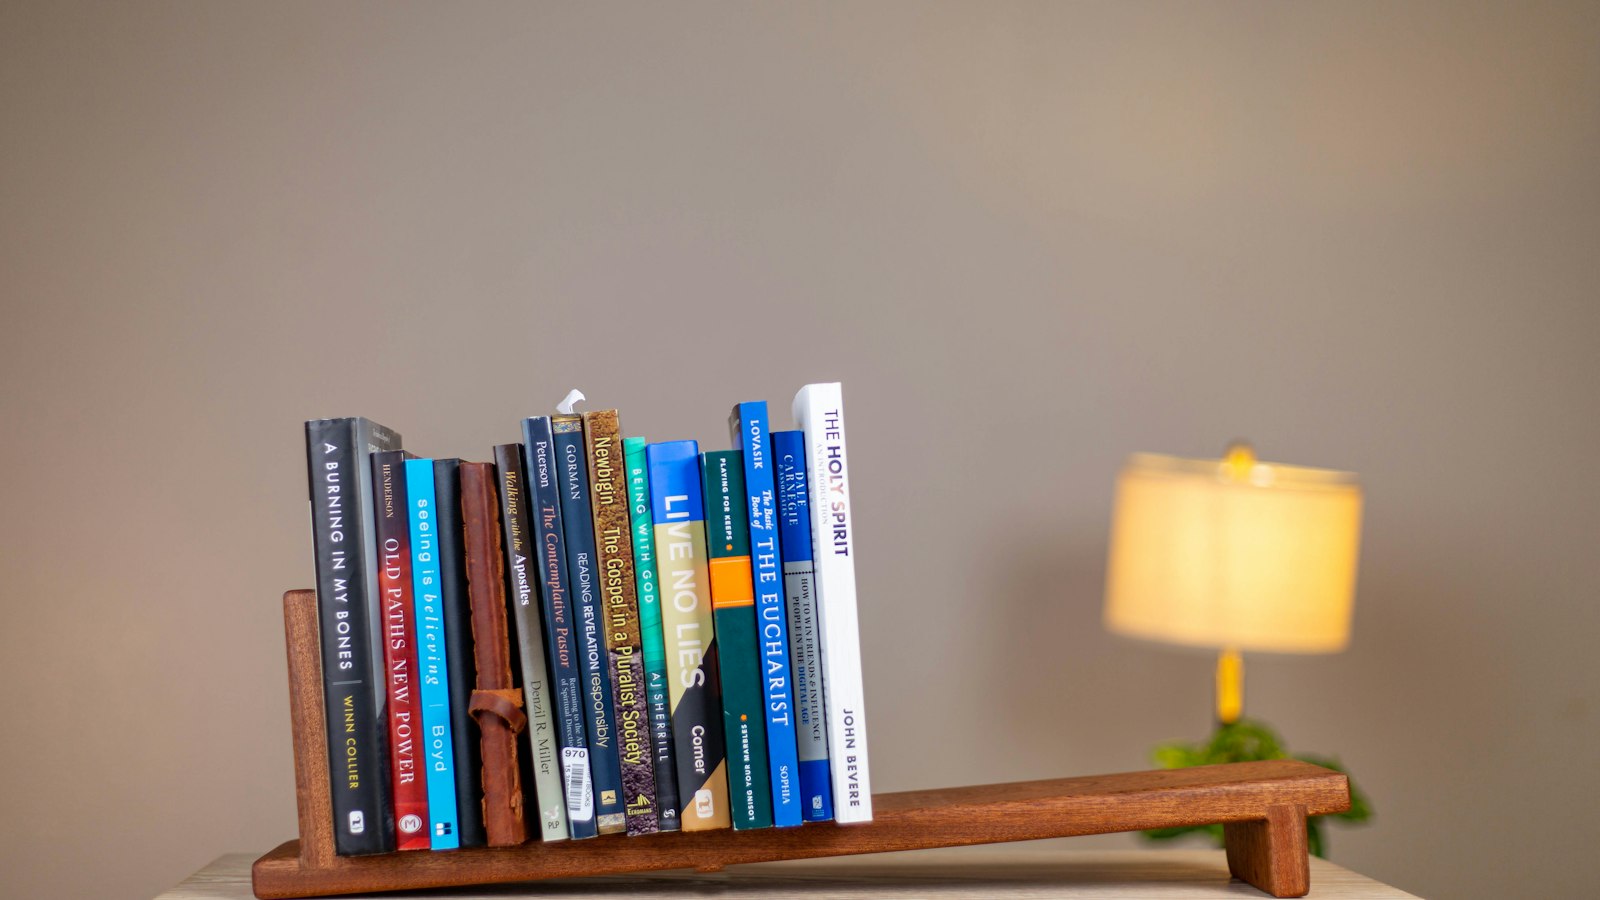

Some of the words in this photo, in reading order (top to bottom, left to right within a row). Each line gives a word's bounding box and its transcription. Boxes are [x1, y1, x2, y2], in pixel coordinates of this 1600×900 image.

[750, 419, 763, 470] LOVASIK
[824, 408, 841, 441] THE
[324, 442, 338, 454] A
[536, 441, 550, 488] Peterson
[816, 443, 823, 455] AN
[382, 464, 394, 518] HENDERSON
[566, 444, 581, 500] GORMAN
[594, 437, 616, 505] Newbigin
[632, 468, 646, 514] BEING
[719, 457, 729, 494] PLAYING
[783, 454, 799, 526] CARNEGIE
[795, 471, 807, 507] DALE
[827, 446, 844, 495] HOLY
[325, 462, 344, 543] BURNING
[504, 471, 518, 515] Walking
[722, 495, 731, 512] FOR
[751, 495, 763, 518] Book
[762, 489, 772, 506] The
[817, 457, 828, 526] INTRODUCTION
[417, 499, 433, 562] seeing
[510, 516, 520, 538] with
[543, 505, 555, 529] The
[664, 494, 694, 561] LIVE
[724, 514, 733, 541] KEEPS
[751, 519, 764, 530] of
[763, 508, 774, 531] Basic
[830, 500, 849, 557] SPIRIT
[331, 551, 346, 569] IN
[384, 538, 401, 580] OLD
[512, 538, 522, 551] the
[603, 527, 620, 554] The
[638, 523, 651, 561] WITH
[757, 537, 777, 583] THE
[333, 579, 348, 603] MY
[422, 570, 433, 585] is
[515, 554, 531, 606] Apostles
[545, 533, 565, 623] Contemplative
[577, 553, 593, 603] READING
[606, 559, 628, 608] Gospel
[642, 570, 655, 603] GOD
[671, 569, 698, 613] NO
[801, 578, 810, 600] HOW
[387, 587, 406, 650] PATHS
[612, 613, 629, 627] in
[792, 596, 802, 633] PEOPLE
[802, 602, 811, 615] TO
[804, 617, 813, 637] WIN
[335, 611, 353, 670] BONES
[423, 594, 441, 685] believing
[556, 627, 570, 668] Pastor
[583, 605, 600, 670] REVELATION
[614, 632, 628, 641] a
[675, 623, 705, 689] LIES
[795, 633, 803, 644] IN
[796, 644, 805, 664] THE
[616, 646, 637, 706] Pluralist
[761, 592, 789, 726] EUCHARIST
[806, 638, 816, 680] FRIENDS
[392, 659, 410, 704] NEW
[530, 680, 546, 718] Denzil
[560, 678, 569, 686] of
[560, 687, 573, 717] Spiritual
[797, 665, 807, 707] DIGITAL
[809, 680, 816, 688] &
[343, 695, 355, 733] WINN
[569, 677, 579, 712] Returning
[574, 723, 582, 734] the
[590, 672, 610, 748] responsibly
[801, 708, 810, 725] AGE
[809, 688, 821, 742] INFLUENCE
[396, 711, 415, 784] POWER
[536, 722, 547, 735] R.
[622, 710, 642, 765] Society
[653, 693, 669, 762] SHERRILL
[741, 724, 751, 762] MARBLES
[843, 708, 856, 749] JOHN
[346, 737, 359, 789] COLLIER
[431, 725, 448, 772] Boyd
[538, 738, 552, 775] Miller
[564, 749, 586, 759] 970
[691, 725, 706, 774] Comer
[744, 764, 752, 787] YOUR
[780, 765, 791, 805] SOPHIA
[846, 755, 860, 807] BEVERE
[547, 820, 560, 830] PLP
[747, 789, 755, 821] LOSING
